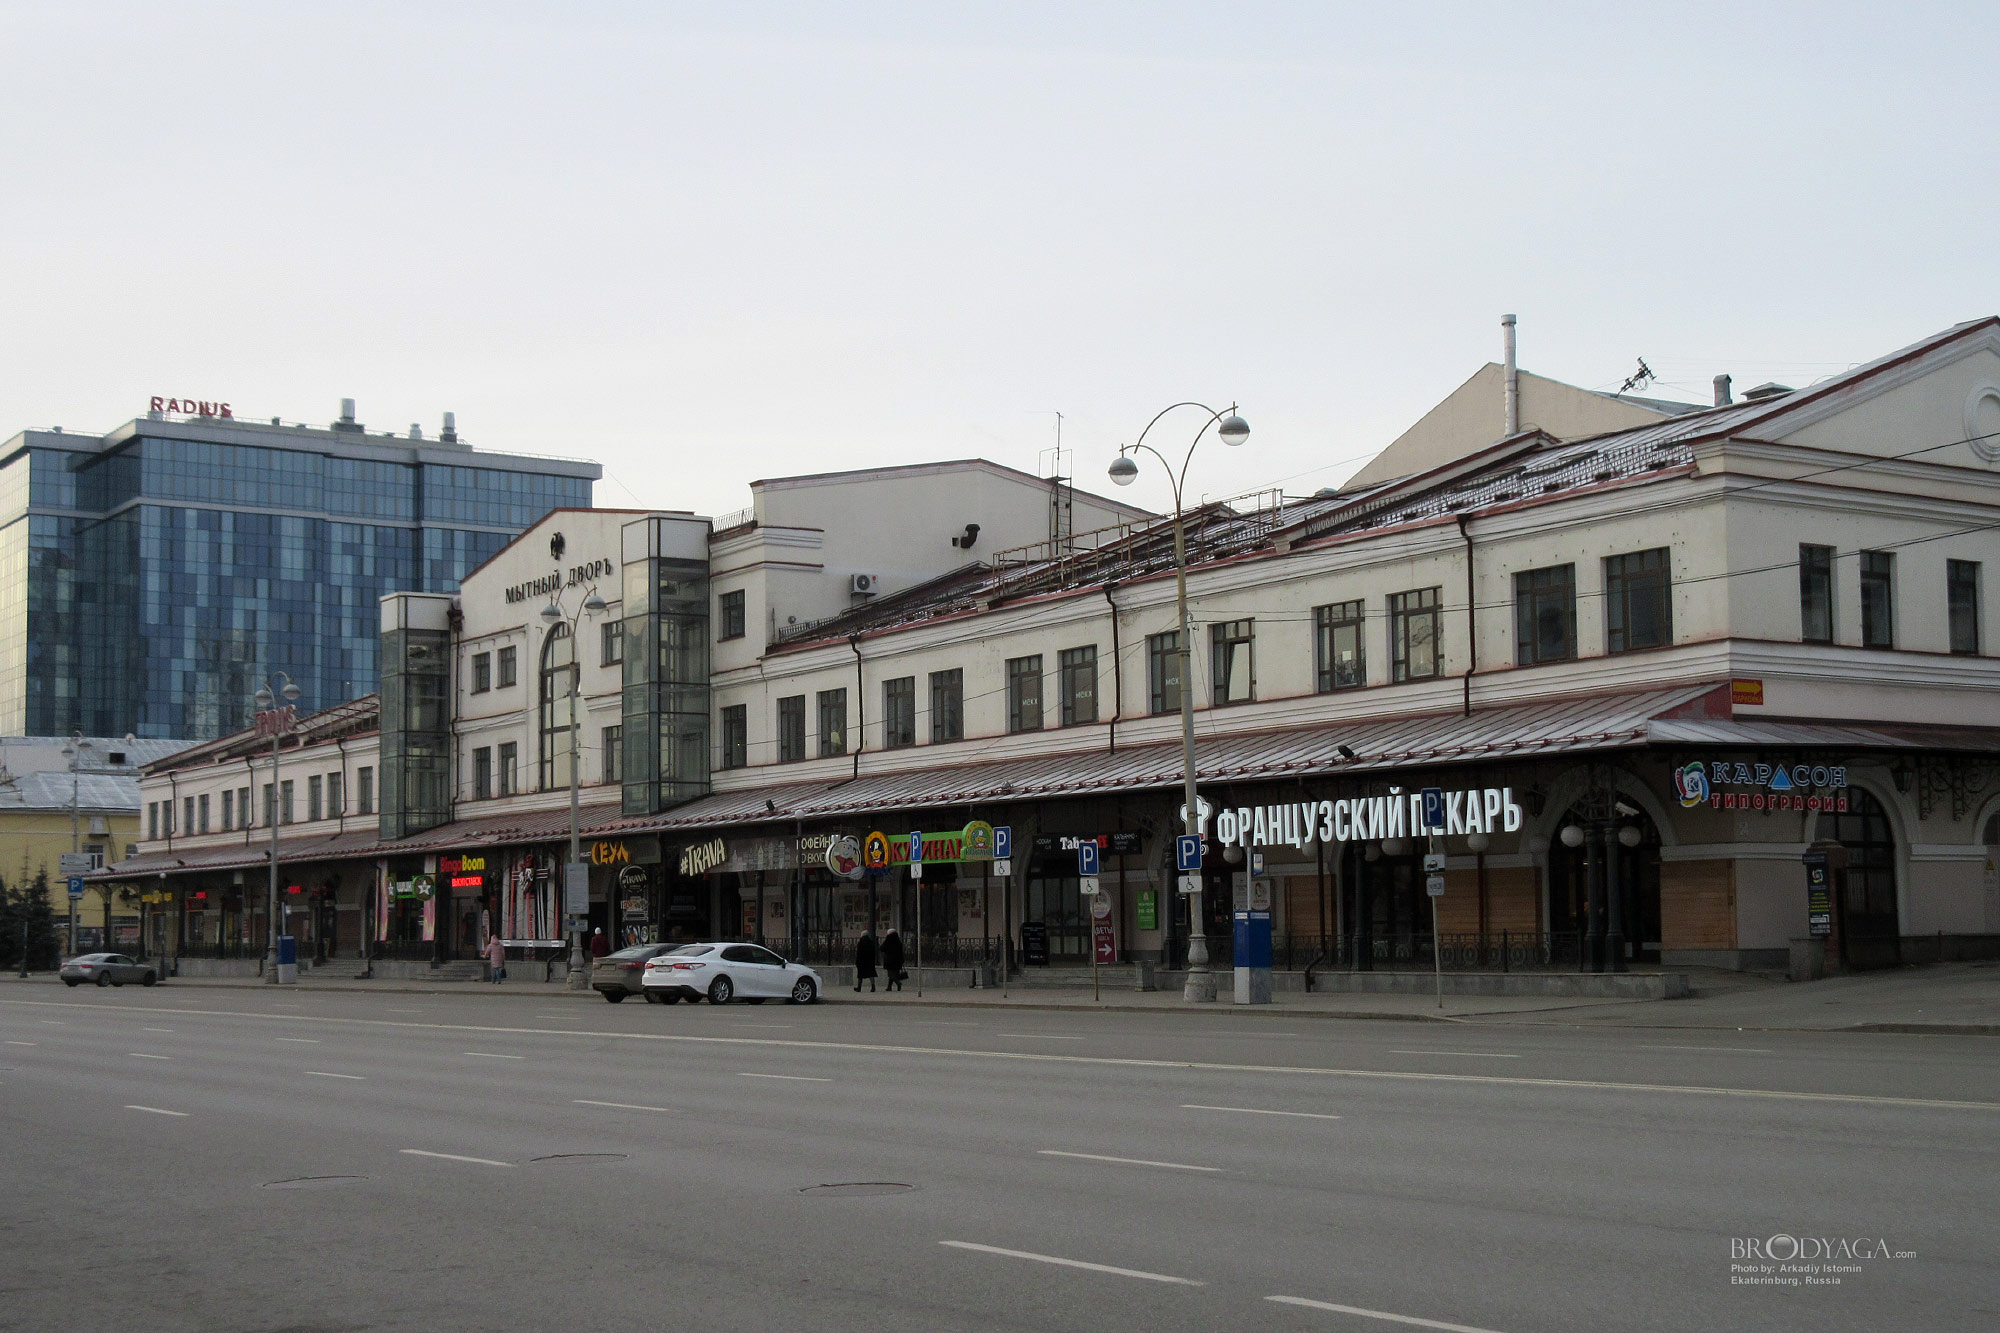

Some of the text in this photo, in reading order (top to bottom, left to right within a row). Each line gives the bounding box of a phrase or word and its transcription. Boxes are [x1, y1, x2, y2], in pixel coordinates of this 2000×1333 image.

[150, 396, 232, 418] RADIUS
[505, 558, 612, 604] МЫТНЫЙ ДВОРЪ
[1710, 794, 1847, 812] ТИПОГРАФИЯ
[1217, 787, 1405, 849] ФРАНЦУЗСКИЙ
[796, 834, 831, 850] ОФЕЙН
[912, 835, 919, 857] P
[997, 831, 1006, 854] P
[1182, 840, 1196, 866] P
[680, 837, 726, 876] #TRAVA
[1083, 846, 1094, 871] P
